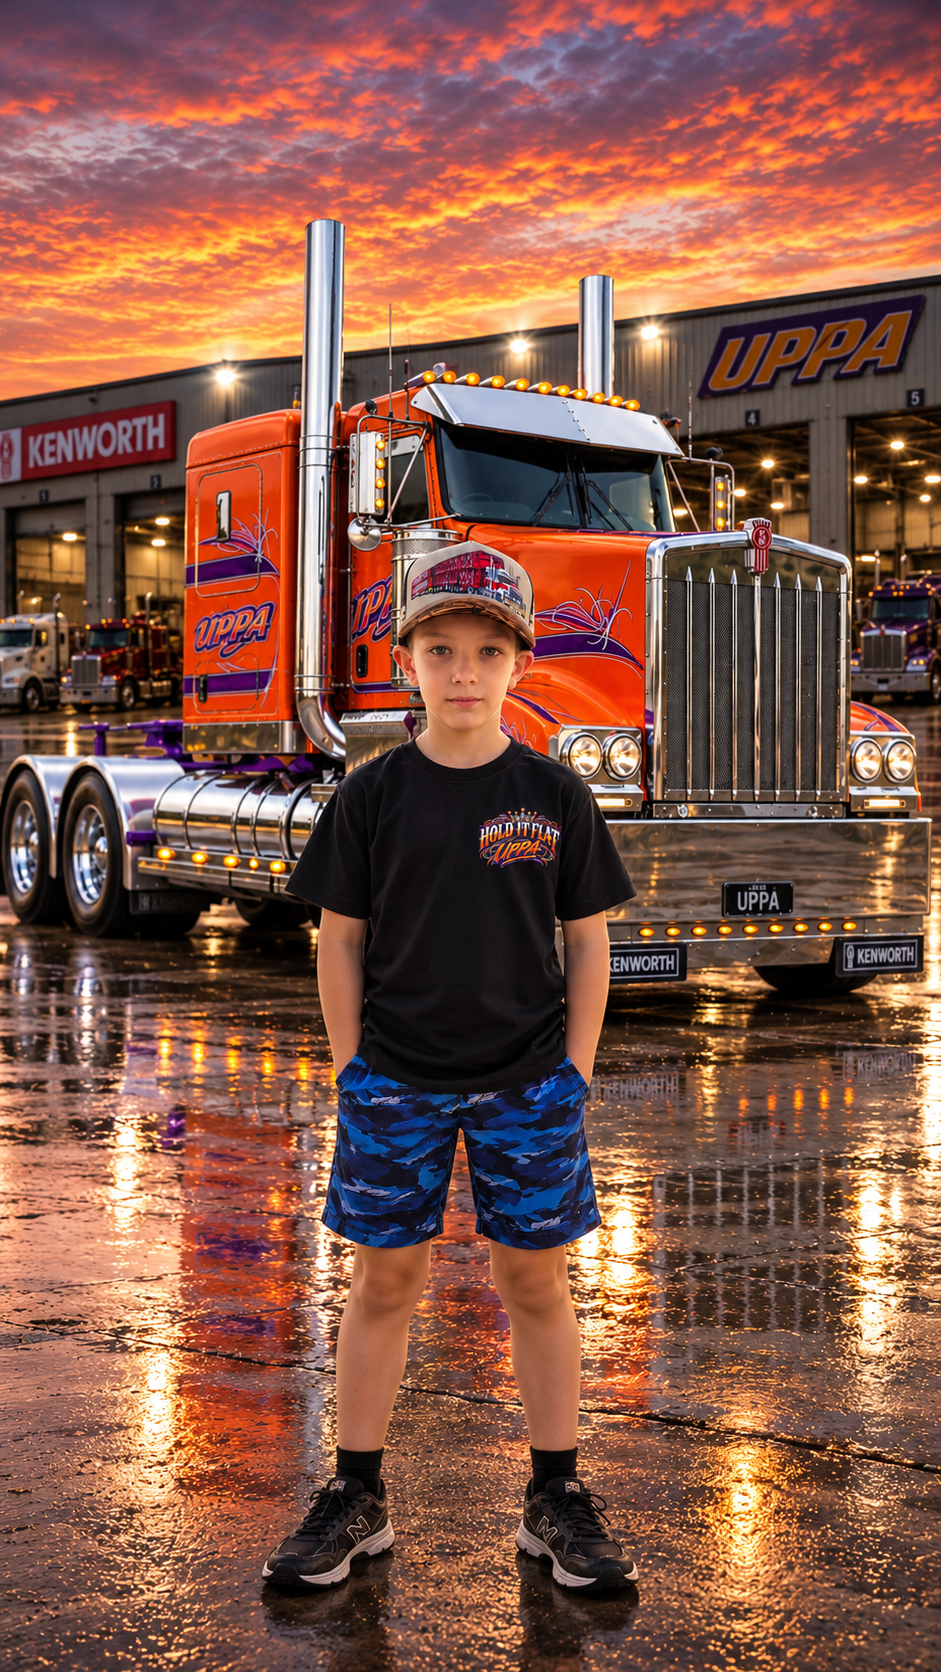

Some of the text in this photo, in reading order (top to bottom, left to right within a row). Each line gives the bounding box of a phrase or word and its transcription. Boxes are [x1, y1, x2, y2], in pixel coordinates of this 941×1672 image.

[708, 310, 913, 391] UPPA
[911, 391, 920, 405] 5
[747, 412, 756, 425] 4
[28, 413, 165, 468] KENWORTH
[195, 602, 274, 657] UPPA
[480, 822, 513, 851] HOLD
[516, 821, 530, 837] IT
[494, 840, 541, 863] UPPA
[737, 891, 780, 911] UPPA
[857, 946, 914, 964] KENWORTH
